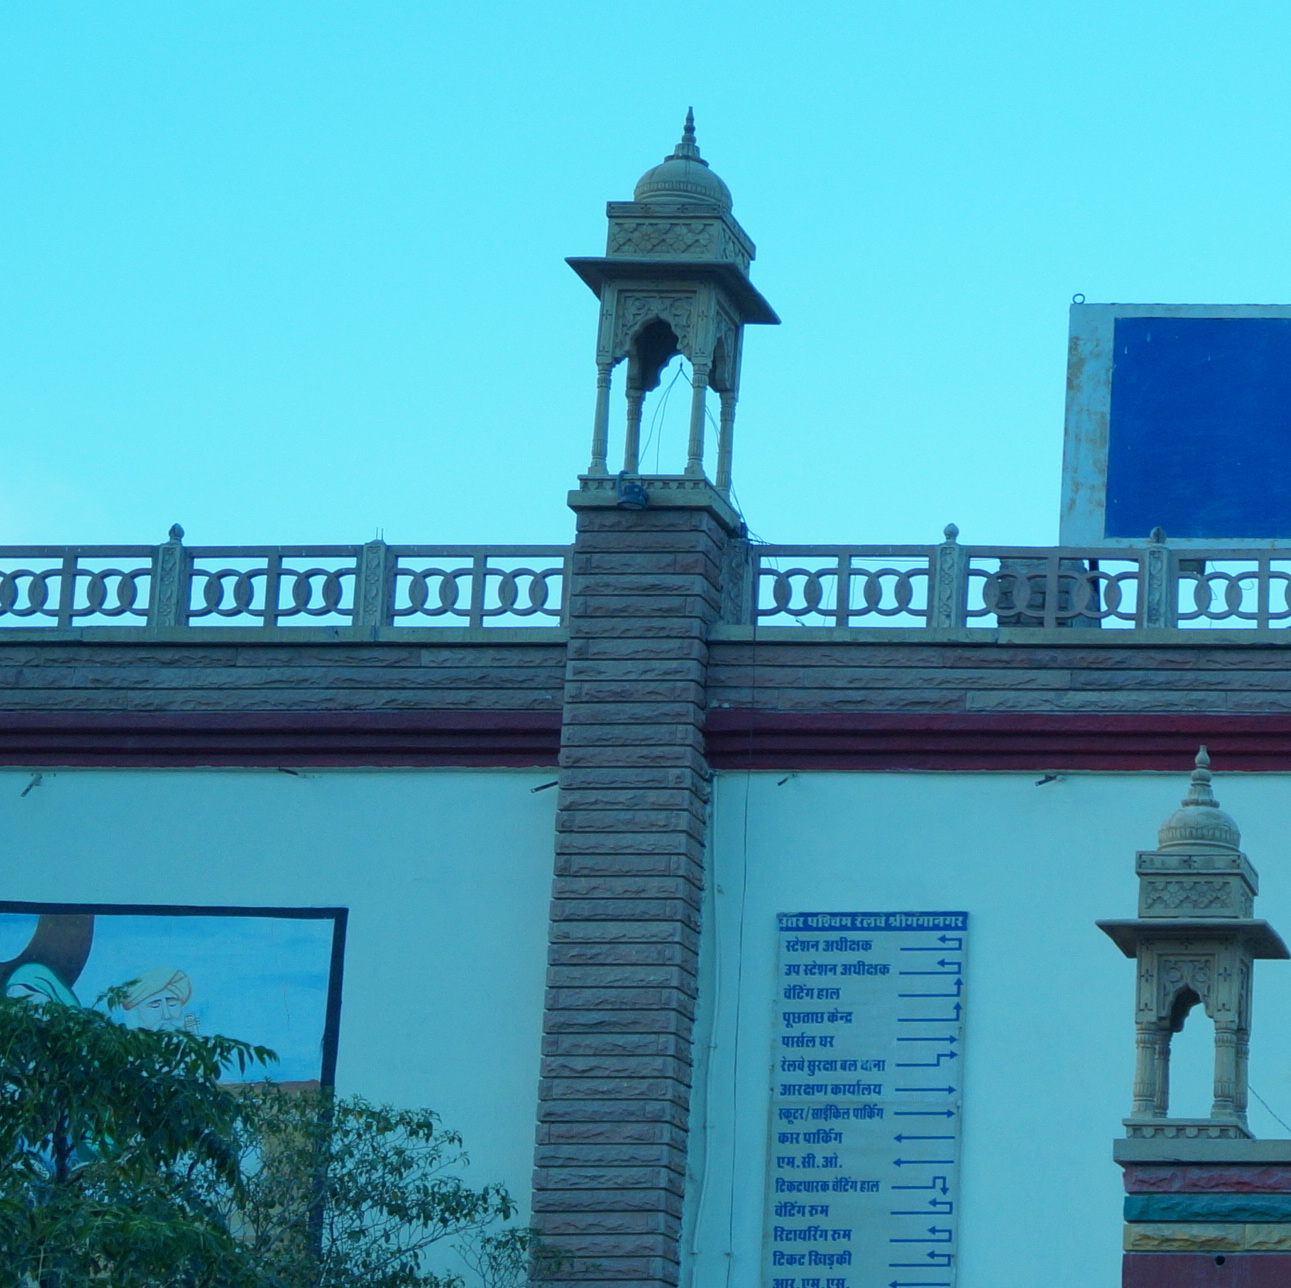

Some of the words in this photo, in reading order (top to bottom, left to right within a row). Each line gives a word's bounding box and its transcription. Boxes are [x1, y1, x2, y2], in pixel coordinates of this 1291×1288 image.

[854, 914, 886, 928] रेलवे
[785, 936, 820, 952] स्टेशन
[822, 936, 872, 952] अधीक्षक
[785, 963, 801, 976] उप
[803, 960, 837, 976] स्टेशन
[840, 960, 890, 976] अधीक्षक
[783, 984, 814, 1000] वेटिंग
[816, 987, 841, 1000] हाल
[782, 1011, 825, 1028] पूछताछ
[827, 1008, 853, 1024] केन्द्र
[819, 1035, 835, 1048] घर
[780, 1056, 805, 1072] रेलवे
[807, 1060, 838, 1077] सुरक्षा
[780, 1084, 829, 1096] आरक्षण
[830, 1079, 883, 1096] कार्यालय
[777, 1131, 801, 1145] कार
[832, 1176, 857, 1193] वेटिंग
[859, 1180, 881, 1193] हाल
[774, 1201, 806, 1217] वेटिंग
[772, 1250, 806, 1266] टिकट
[808, 1250, 852, 1269] खिड़की
